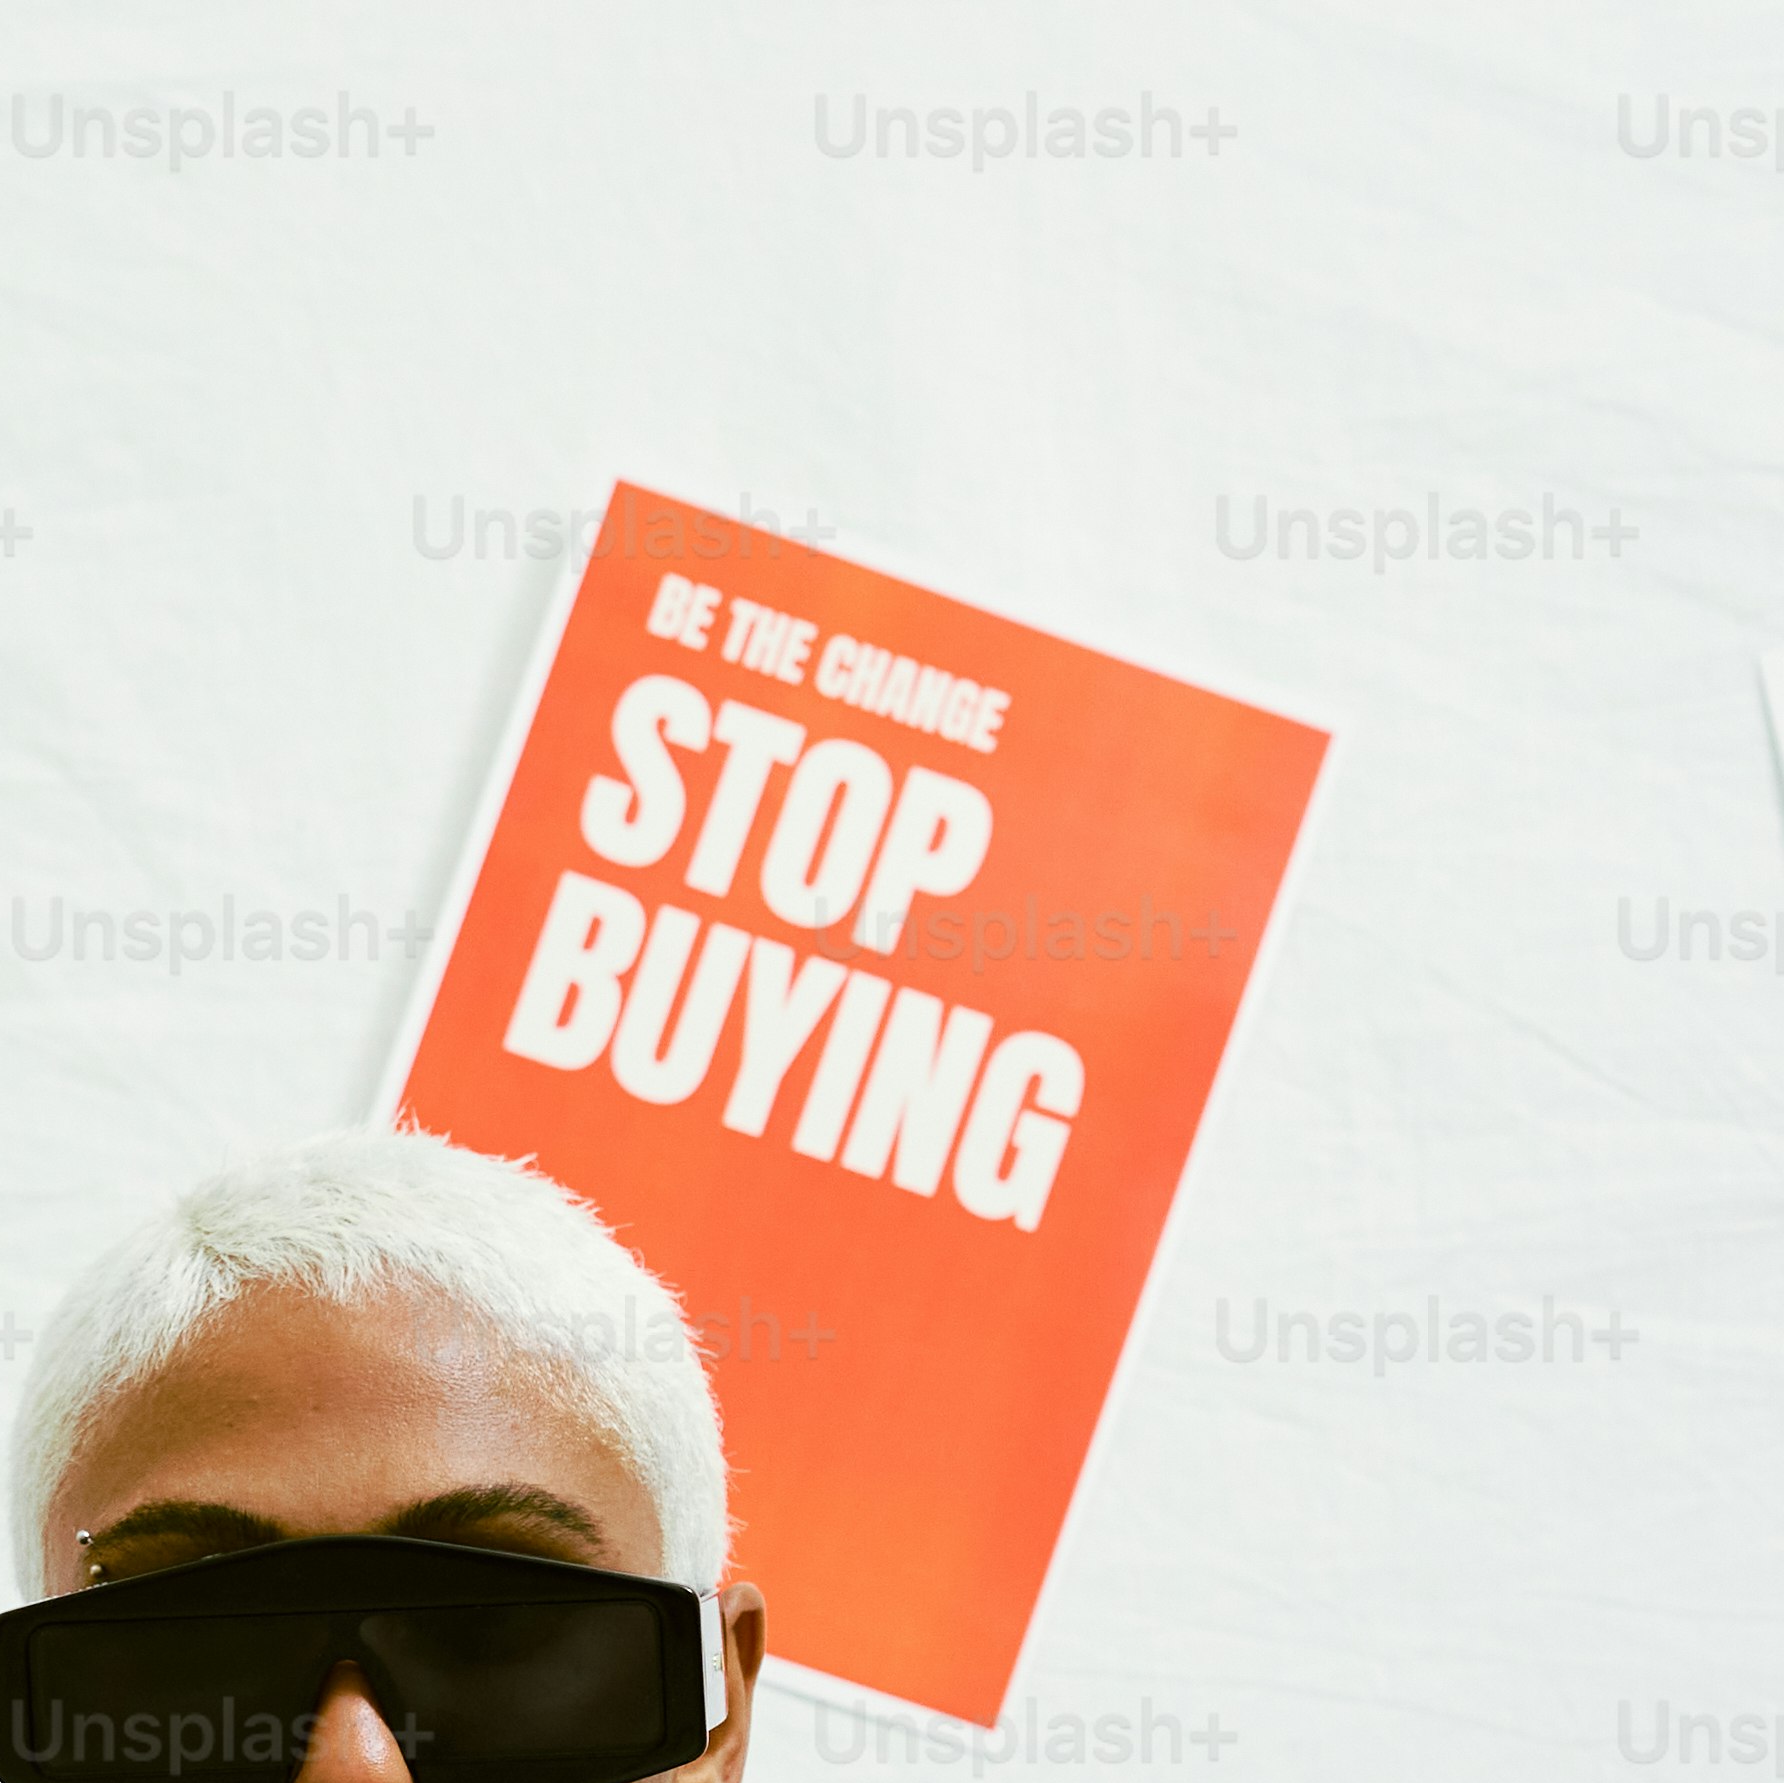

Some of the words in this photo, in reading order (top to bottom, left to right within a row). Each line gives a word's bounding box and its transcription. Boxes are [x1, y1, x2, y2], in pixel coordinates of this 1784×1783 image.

[647, 572, 723, 651] BE
[721, 597, 819, 686] THE
[815, 634, 1012, 754] CHANGE
[580, 674, 993, 956] STOP
[502, 869, 1086, 1233] BUYING
